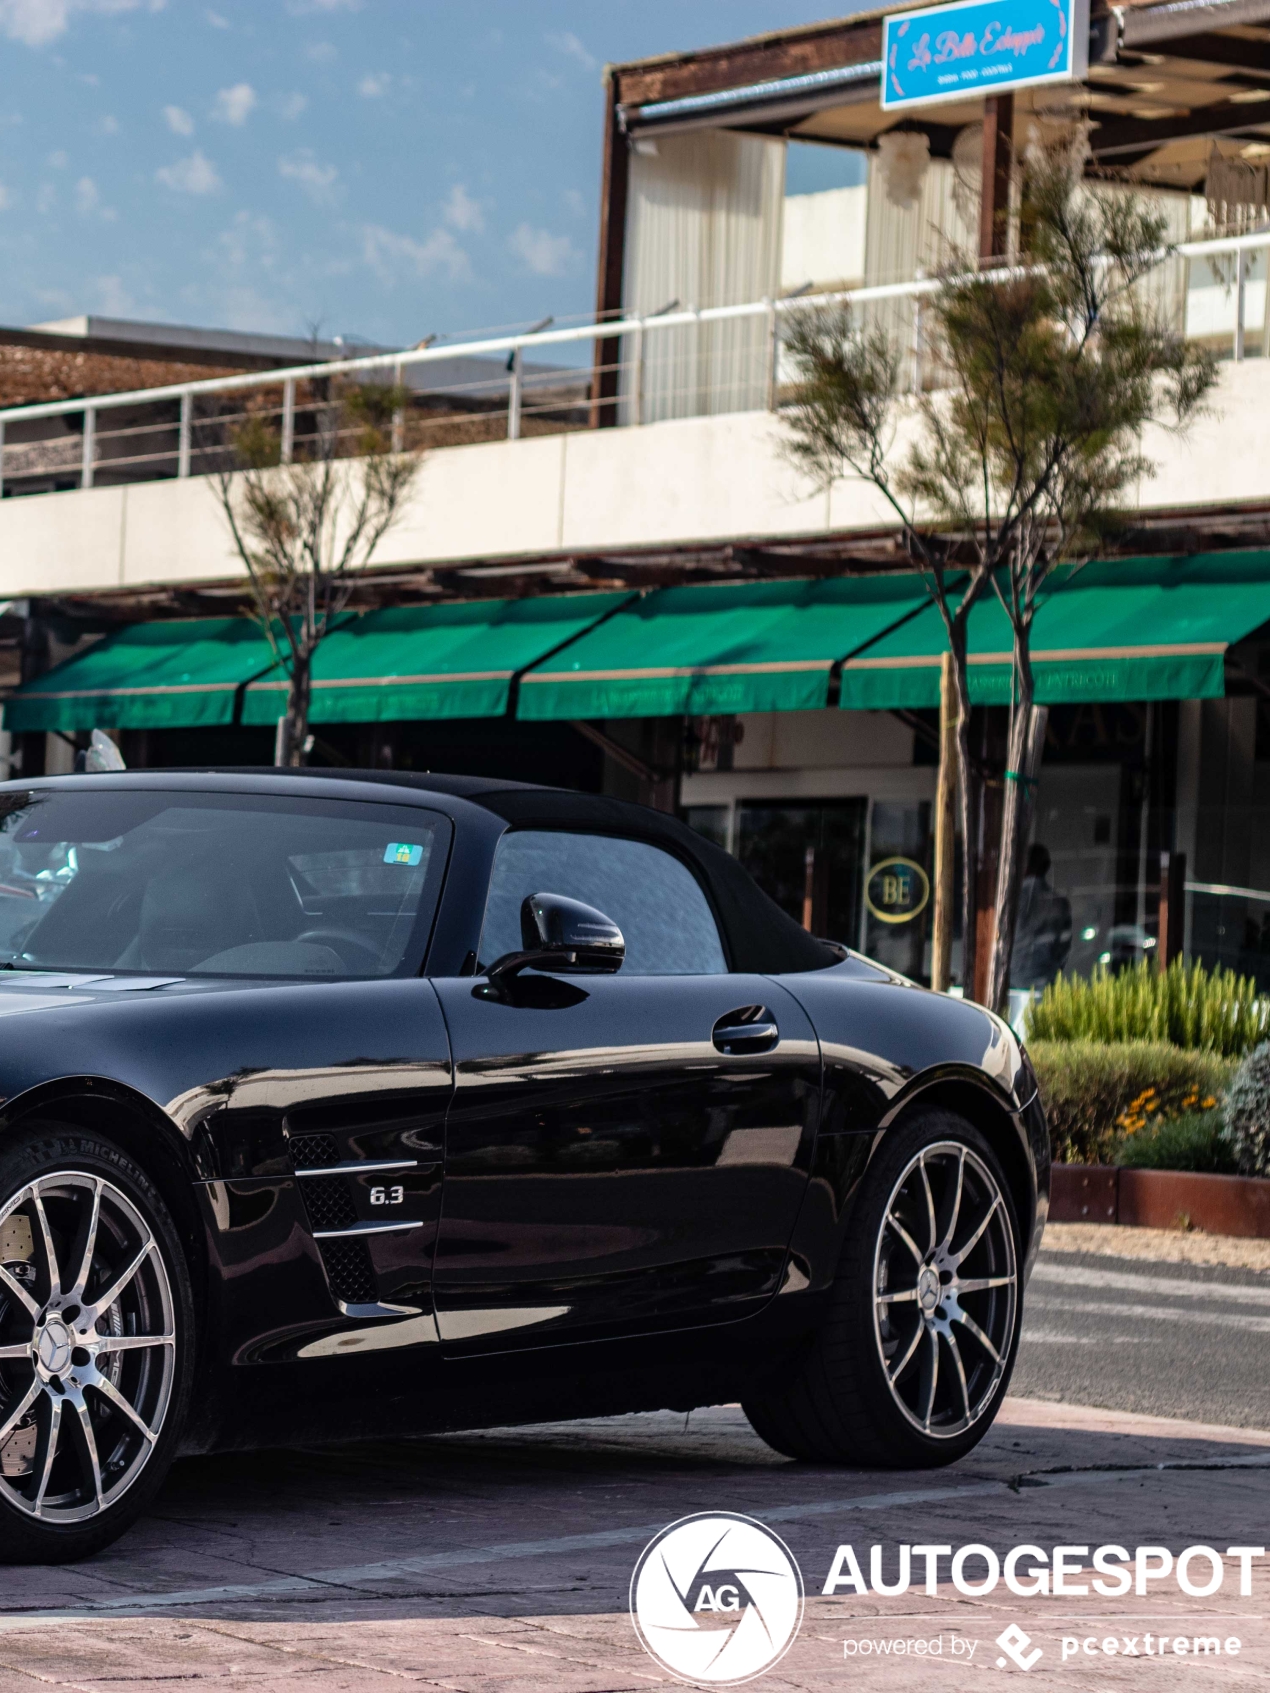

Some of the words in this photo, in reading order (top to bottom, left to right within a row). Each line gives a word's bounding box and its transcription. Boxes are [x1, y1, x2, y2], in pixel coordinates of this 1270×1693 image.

[882, 874, 911, 905] BE
[80, 1139, 150, 1190] MICHELIN
[370, 1185, 404, 1205] 6.3
